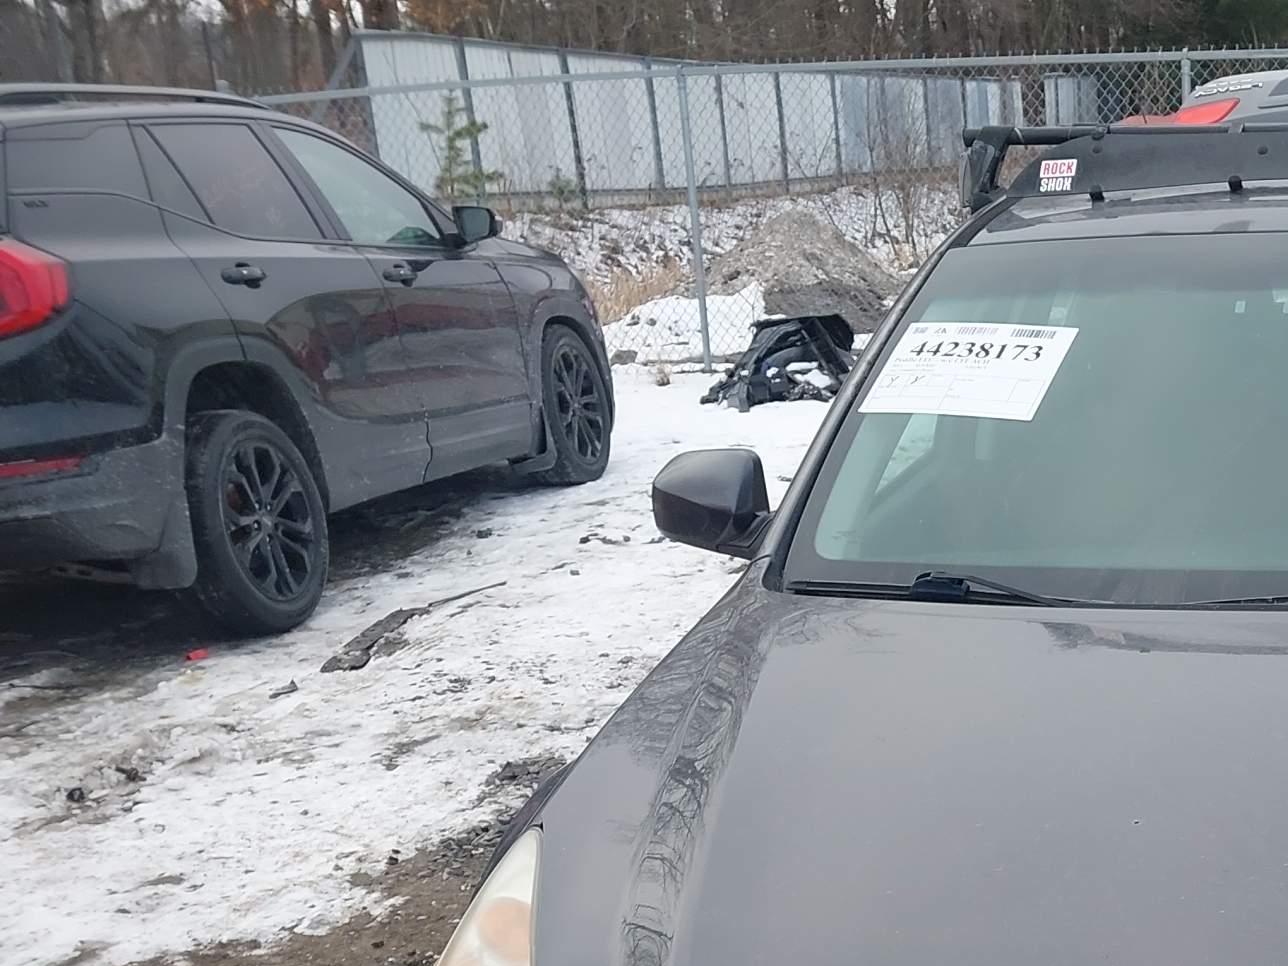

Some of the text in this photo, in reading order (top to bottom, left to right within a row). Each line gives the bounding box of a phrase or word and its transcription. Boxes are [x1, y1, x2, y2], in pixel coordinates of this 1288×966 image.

[1043, 161, 1074, 175] ROCK
[1040, 177, 1072, 192] SHOX
[909, 340, 1044, 361] 44238173
